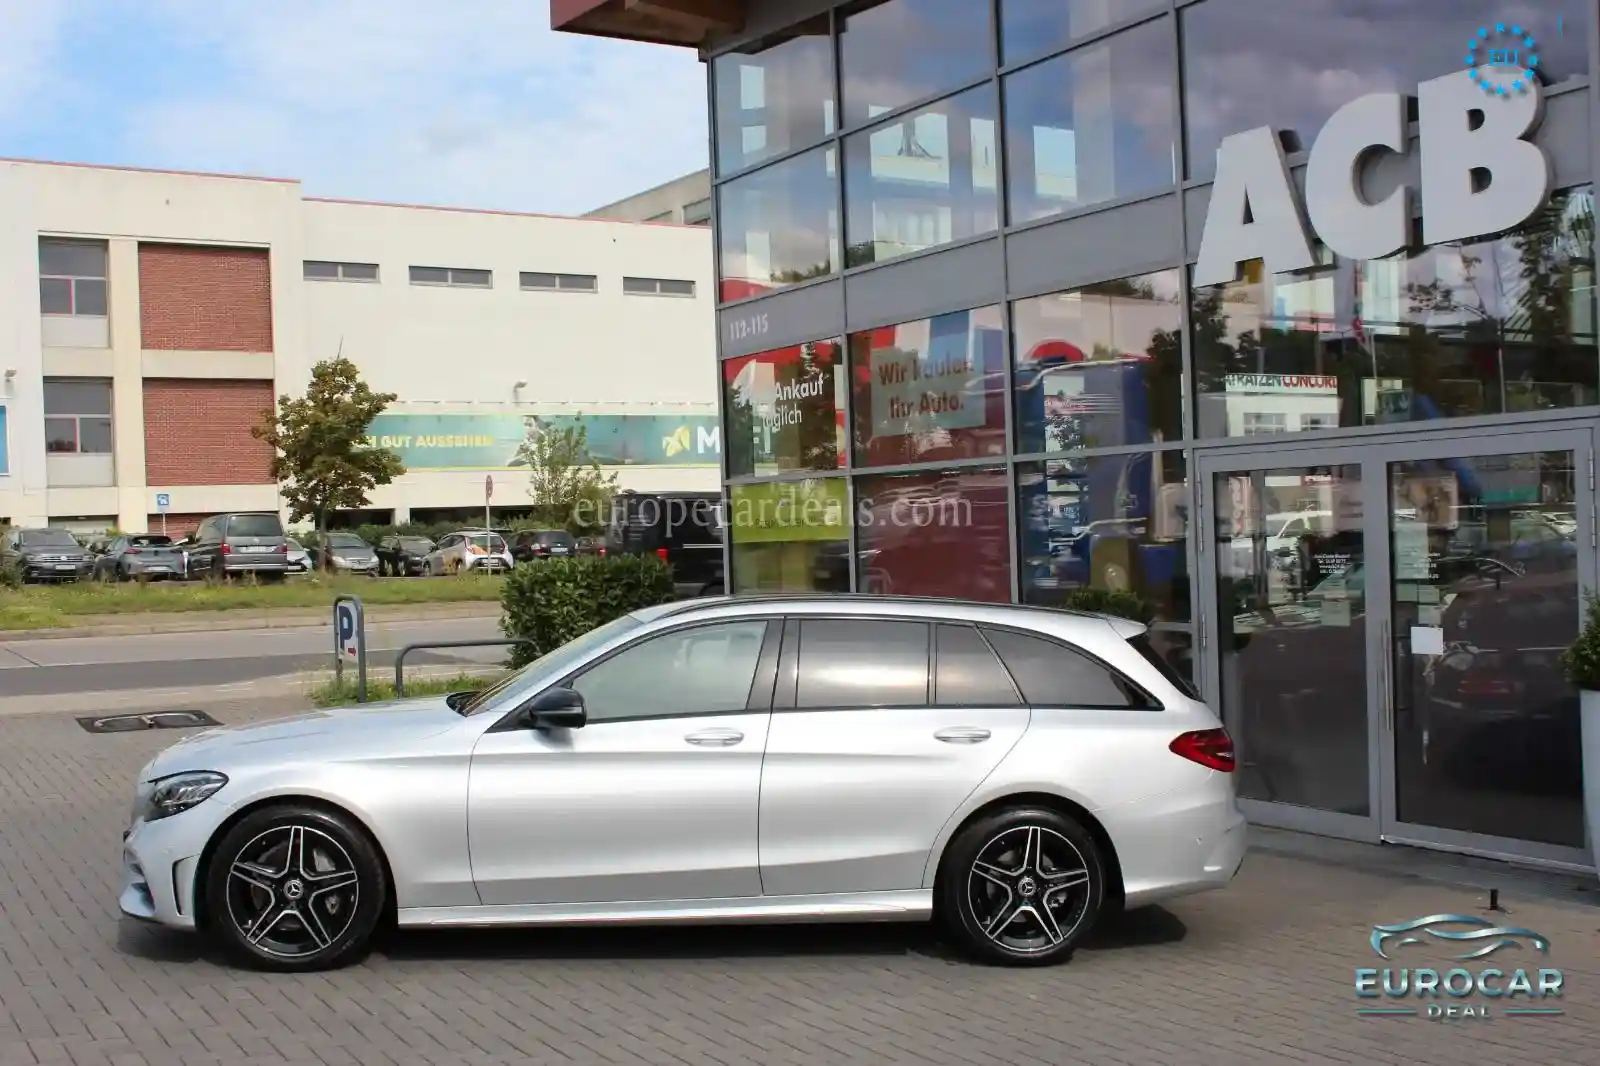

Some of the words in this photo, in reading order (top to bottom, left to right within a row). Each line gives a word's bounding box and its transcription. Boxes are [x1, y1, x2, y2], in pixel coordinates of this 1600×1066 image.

[1194, 63, 1551, 287] ACB
[729, 314, 770, 342] 112-115
[774, 372, 824, 401] Ankauf
[879, 362, 907, 385] Wir
[889, 396, 914, 419] Ihr
[919, 391, 964, 416] Auto.
[338, 606, 354, 652] P
